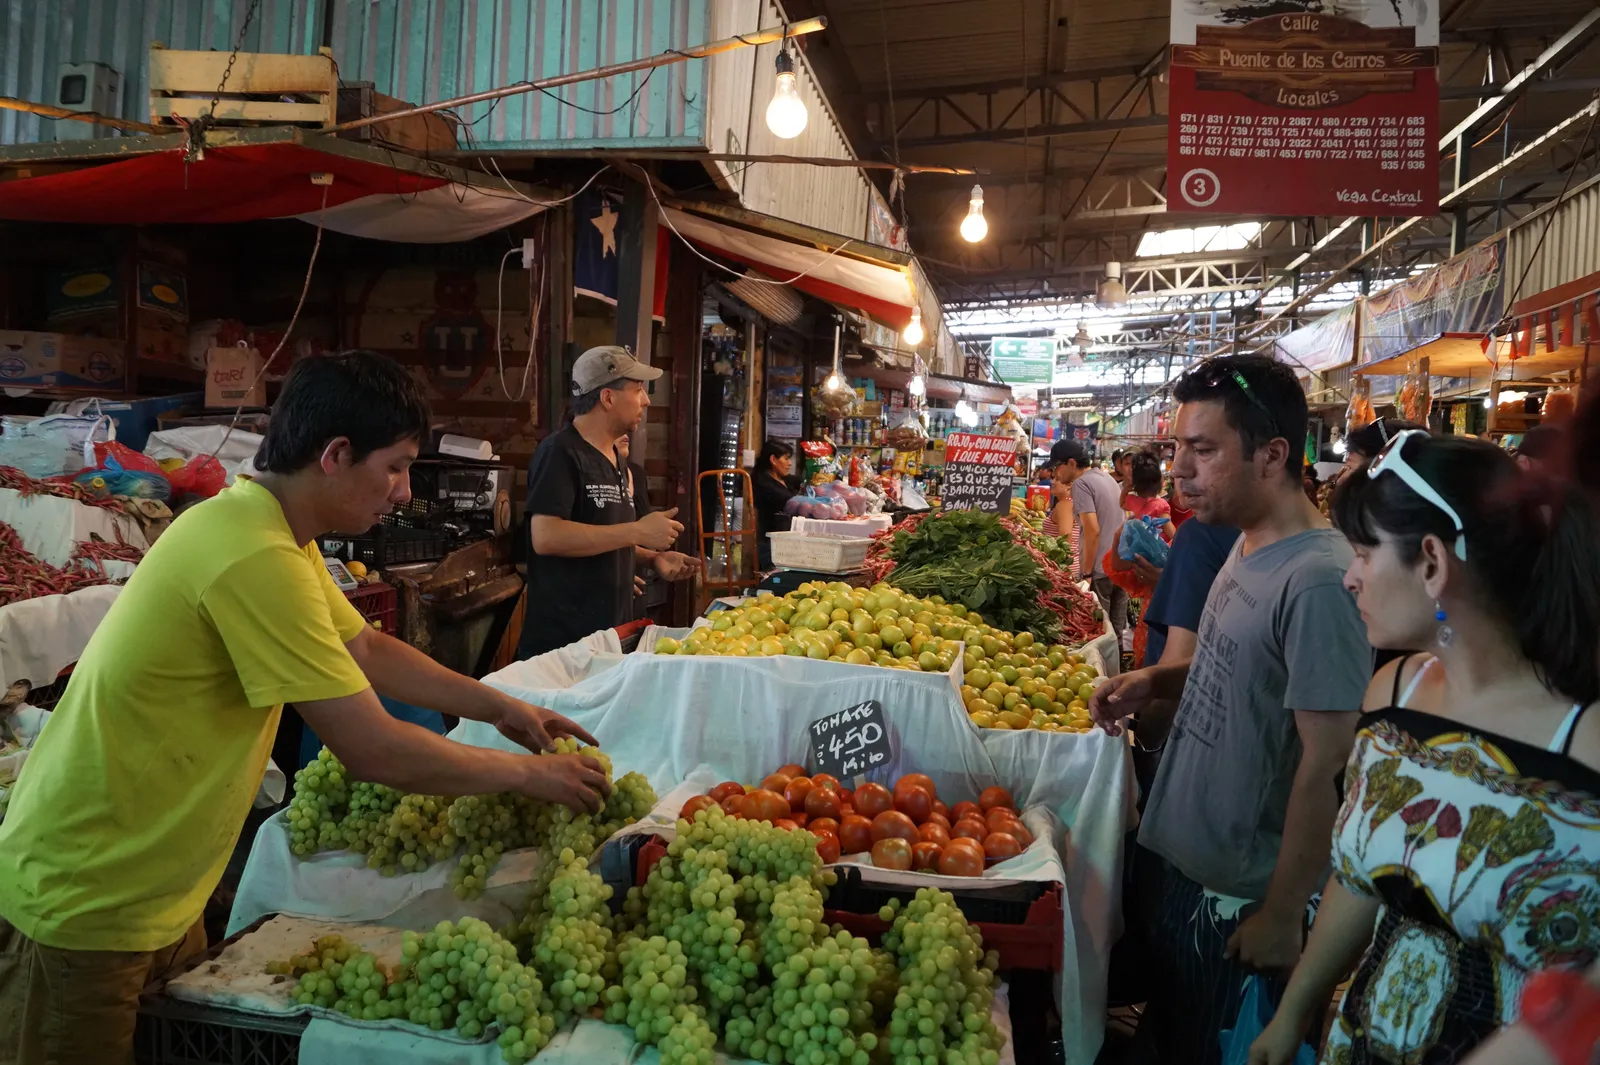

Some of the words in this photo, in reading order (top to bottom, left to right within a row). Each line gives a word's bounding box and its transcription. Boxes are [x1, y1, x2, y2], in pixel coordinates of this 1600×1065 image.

[1280, 16, 1320, 31] Calle
[1220, 48, 1270, 68] Puente
[1277, 52, 1296, 68] de
[1303, 52, 1324, 68] los
[1331, 50, 1386, 68] Carros
[1276, 88, 1339, 106] Locales
[1181, 114, 1196, 122] 671
[1207, 115, 1223, 123] 831
[1235, 116, 1252, 124] 710
[1262, 117, 1279, 125] 270
[1289, 117, 1312, 126] 2087
[1322, 118, 1340, 126] 880
[1350, 118, 1368, 126] 279
[1379, 117, 1396, 125] 734
[1407, 117, 1424, 125] 683
[1180, 124, 1197, 133] 269
[1206, 126, 1222, 134] 727
[1231, 127, 1248, 135] 739
[1256, 127, 1273, 136] 735
[1282, 128, 1298, 136] 725
[1308, 128, 1325, 136] 740
[1407, 128, 1425, 136] 848
[1180, 135, 1196, 144] 651
[1206, 136, 1222, 145] 473
[1232, 137, 1254, 146] 2107
[1263, 138, 1280, 147] 639
[1289, 139, 1311, 147] 2022
[1321, 139, 1342, 147] 2041
[1354, 139, 1369, 147] 141
[1407, 139, 1424, 147] 697
[1180, 146, 1195, 154] 661
[1205, 147, 1221, 156] 637
[1229, 148, 1246, 156] 687
[1254, 149, 1270, 157] 981
[1279, 150, 1296, 158] 453
[1304, 150, 1321, 158] 970
[1330, 150, 1347, 158] 722
[1356, 150, 1372, 158] 782
[1382, 150, 1398, 158] 684
[1408, 150, 1425, 158] 445
[1382, 161, 1398, 169] 935
[1408, 161, 1425, 169] 936
[1194, 178, 1205, 195] 3
[1336, 189, 1368, 203] Vega
[1372, 189, 1423, 202] Central
[947, 434, 970, 447] ROJO
[975, 437, 992, 449] CON
[991, 438, 1018, 453] GRANO
[982, 452, 1012, 465] MAS!
[946, 462, 957, 471] LO
[988, 466, 1014, 475] MALO
[950, 473, 963, 483] ES
[965, 473, 988, 484] QUE
[991, 475, 1011, 486] SON
[948, 485, 995, 496] BARATOS
[813, 702, 874, 735] TOMATE
[829, 722, 882, 759] 450
